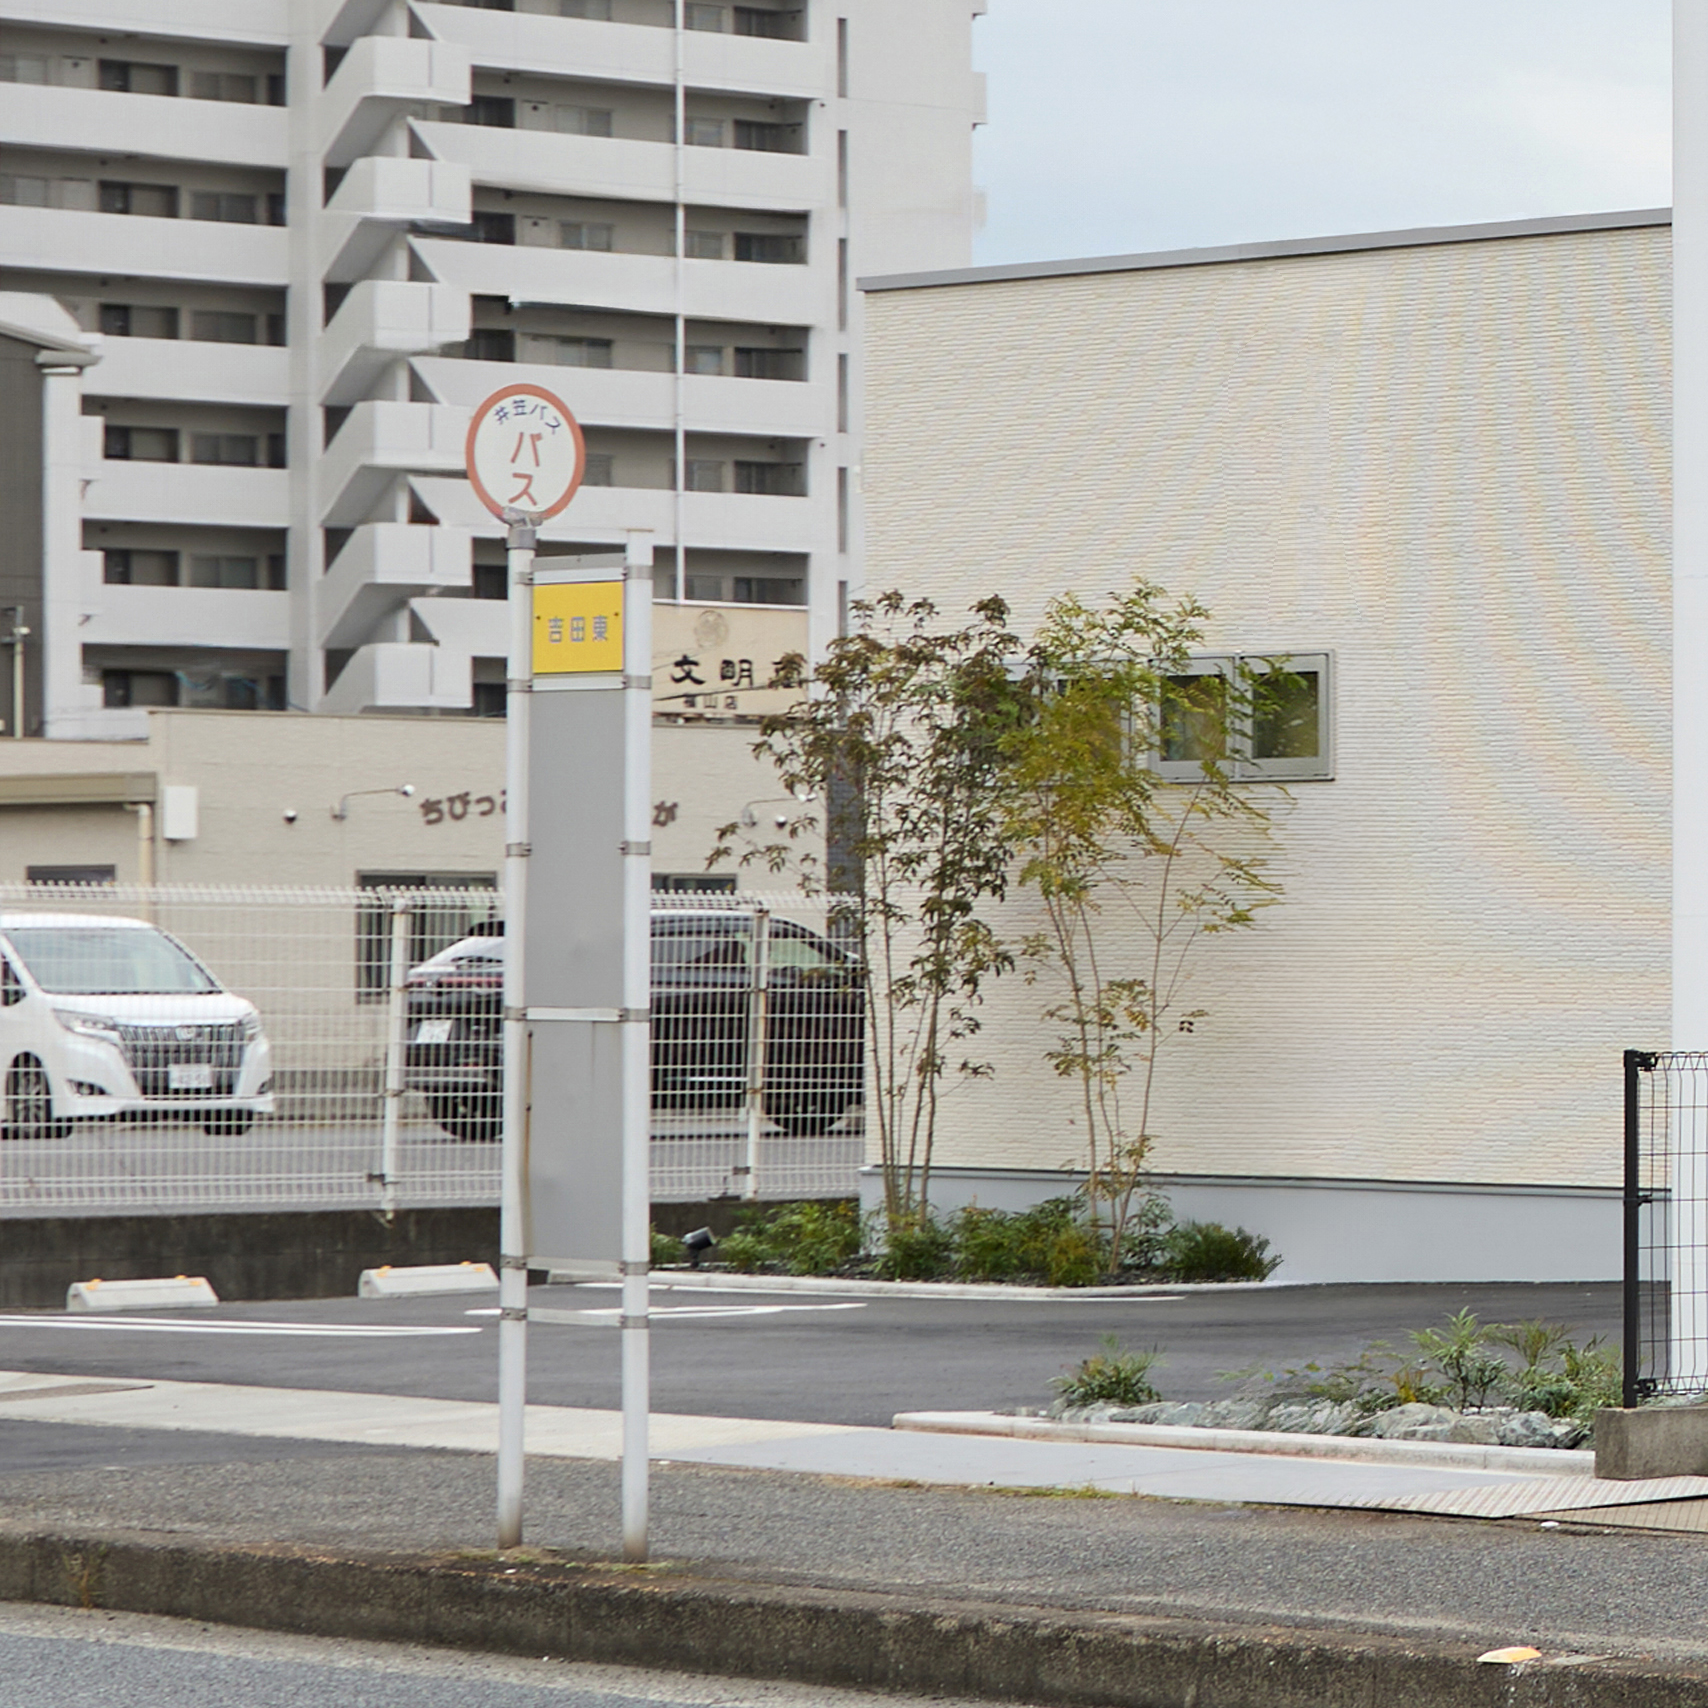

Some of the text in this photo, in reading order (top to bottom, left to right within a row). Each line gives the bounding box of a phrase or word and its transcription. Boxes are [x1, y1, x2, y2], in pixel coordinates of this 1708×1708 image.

[494, 399, 561, 435] 井笠バス
[508, 431, 543, 506] バス
[548, 615, 608, 643] 吉田東
